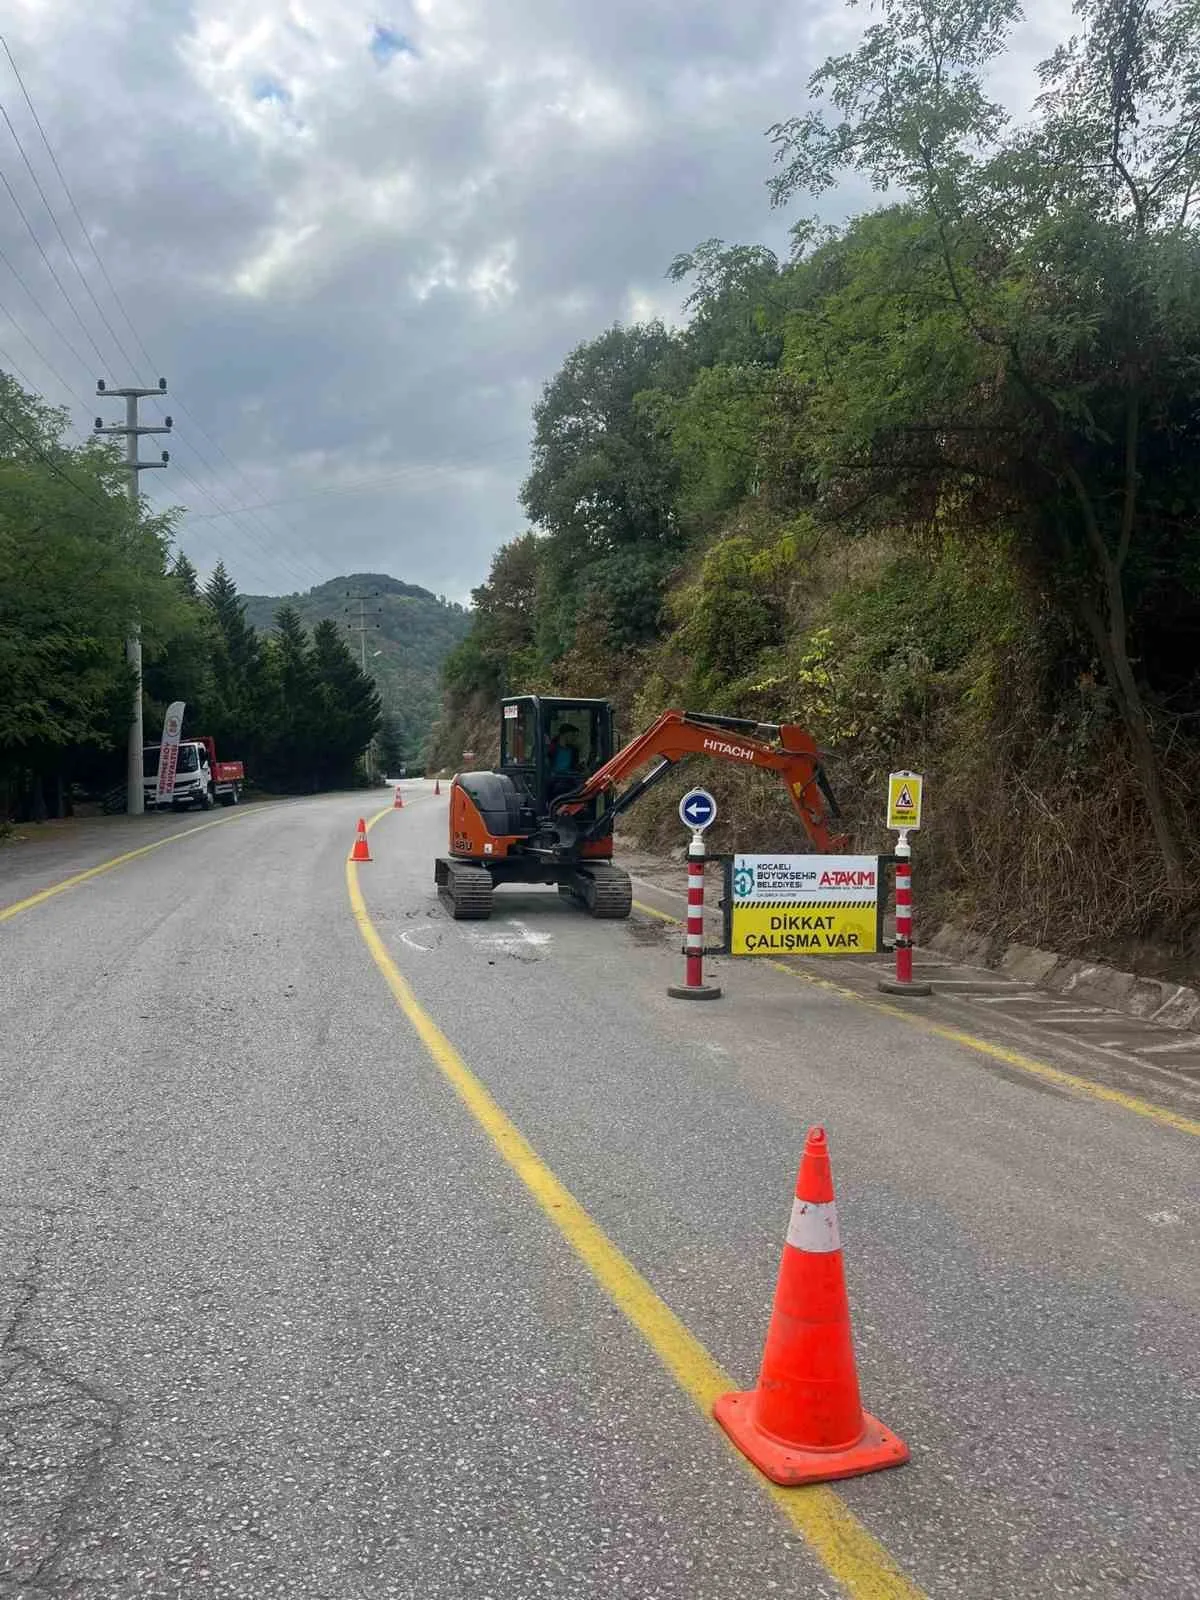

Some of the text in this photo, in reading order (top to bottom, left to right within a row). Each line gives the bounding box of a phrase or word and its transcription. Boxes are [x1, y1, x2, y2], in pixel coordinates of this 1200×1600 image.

[703, 738, 754, 760] HITACHI
[757, 863, 791, 871] KOCAELİ
[757, 880, 802, 889] BELEDİYESİ
[819, 871, 875, 886] A-TAKIMI
[770, 913, 835, 930] DİKKAT
[745, 934, 859, 951] ÇALIŞMA VAR
